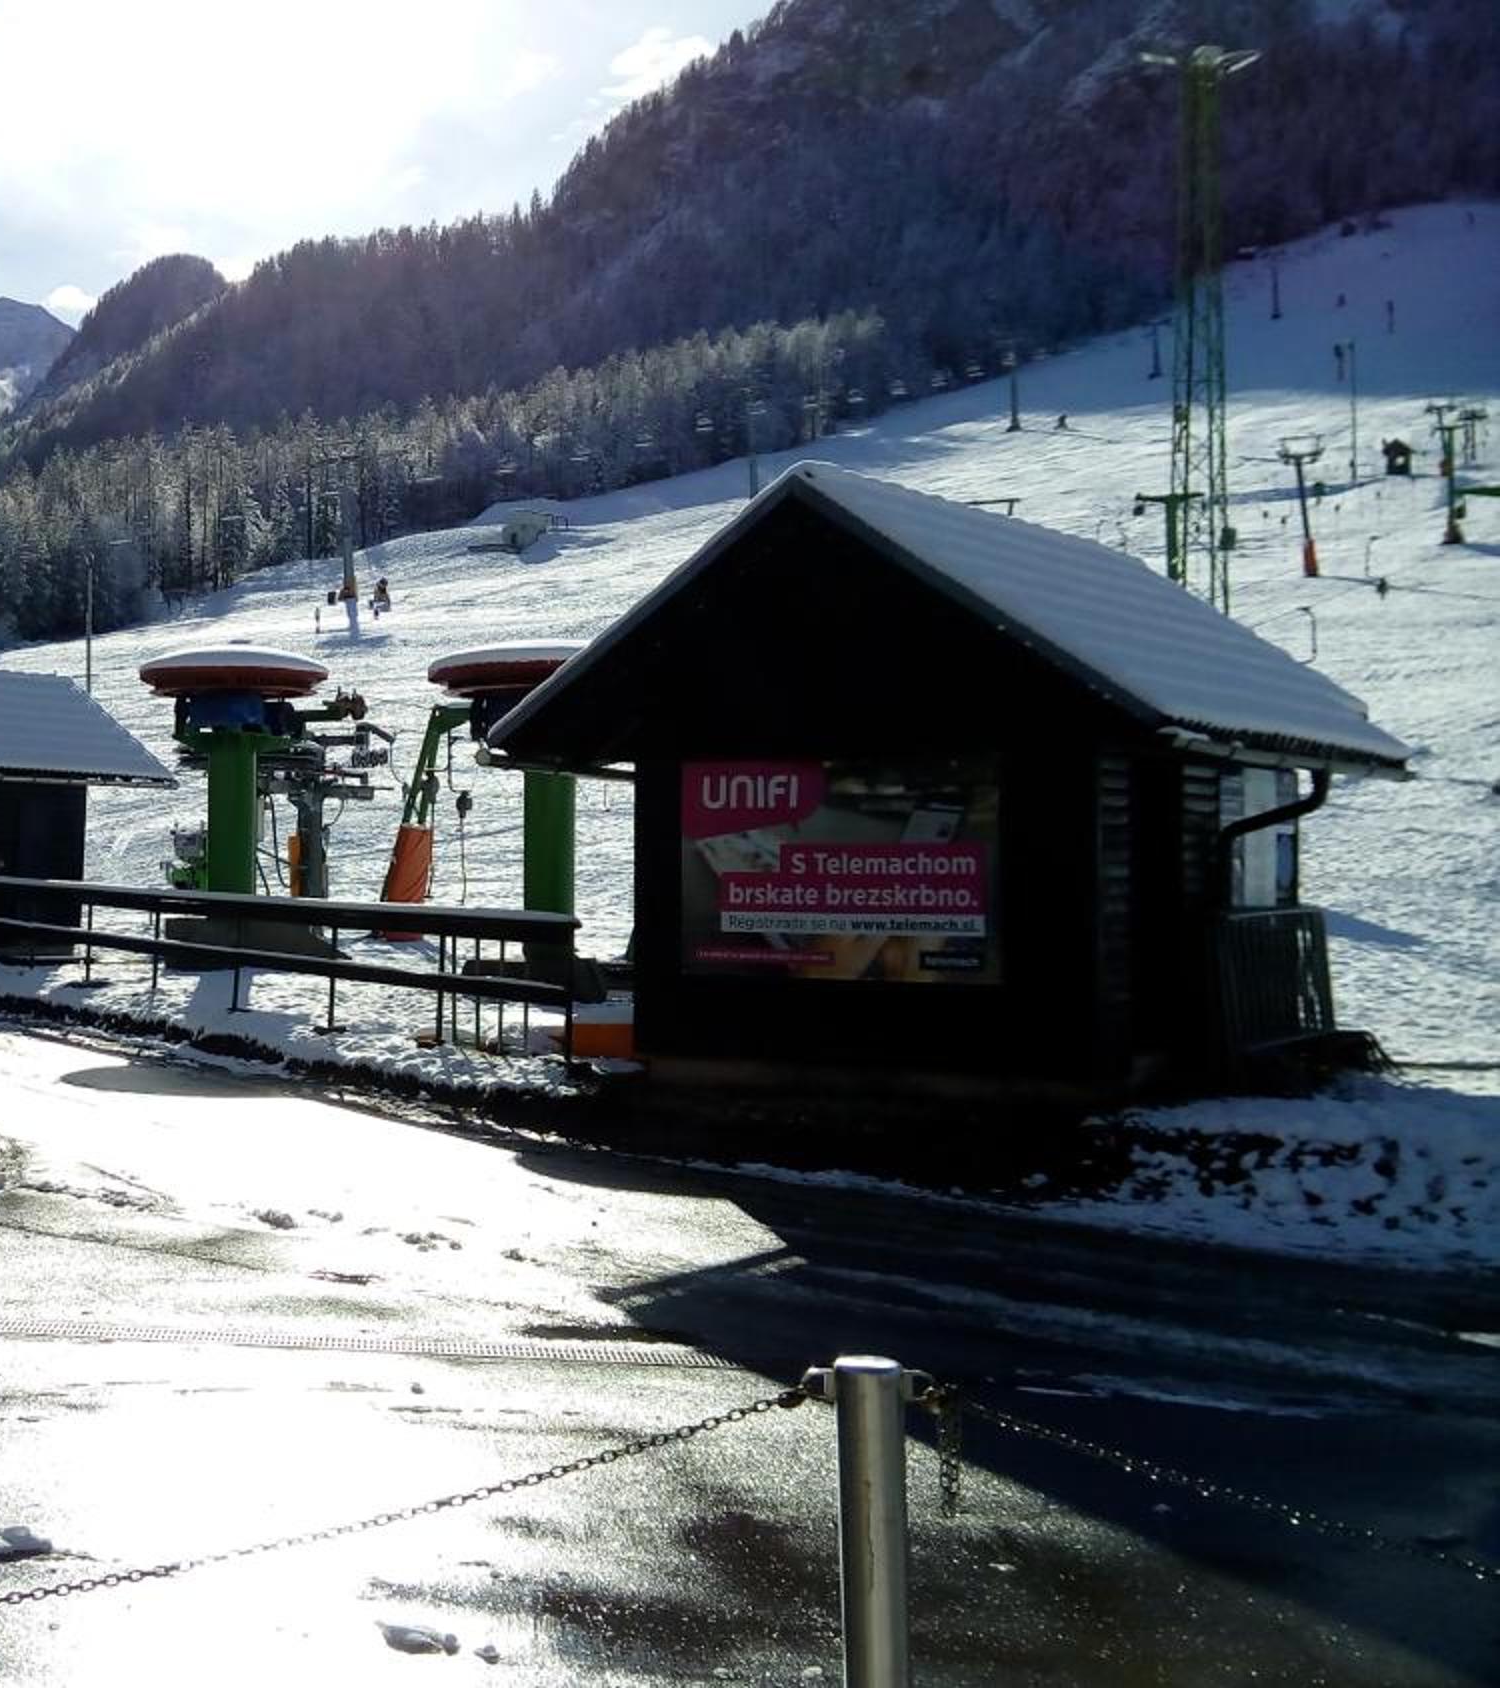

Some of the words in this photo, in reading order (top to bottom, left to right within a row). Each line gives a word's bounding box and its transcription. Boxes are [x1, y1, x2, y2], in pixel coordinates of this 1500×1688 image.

[702, 775, 799, 810] UNIFI
[790, 853, 806, 875] S
[814, 852, 977, 876] Telemachom
[728, 881, 819, 906] brskate
[826, 882, 979, 908] brezskrbno.
